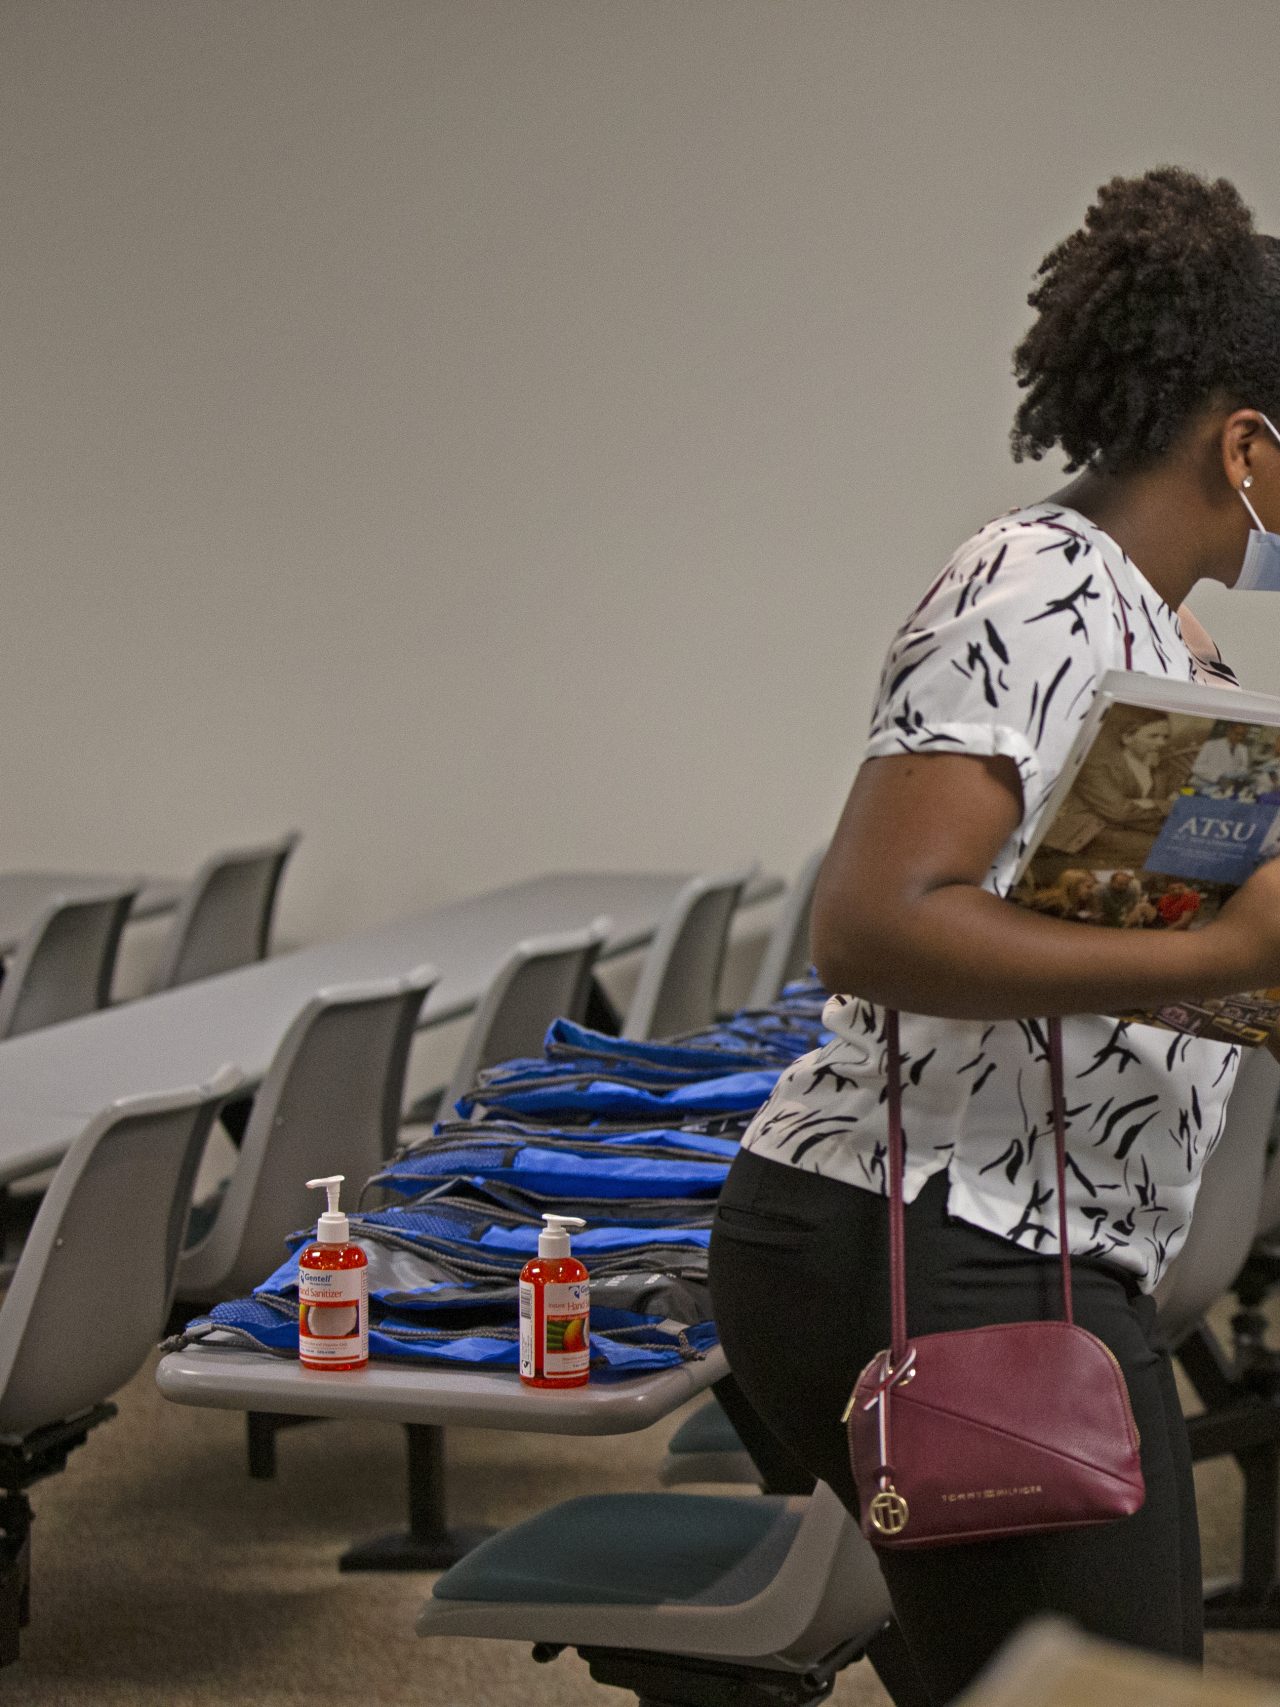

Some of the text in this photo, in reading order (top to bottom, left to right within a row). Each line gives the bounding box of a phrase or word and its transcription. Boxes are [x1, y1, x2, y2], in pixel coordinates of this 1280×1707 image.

[1177, 816, 1257, 841] ATSU
[305, 1273, 331, 1283] Gentell
[311, 1288, 343, 1298] Sanitizer
